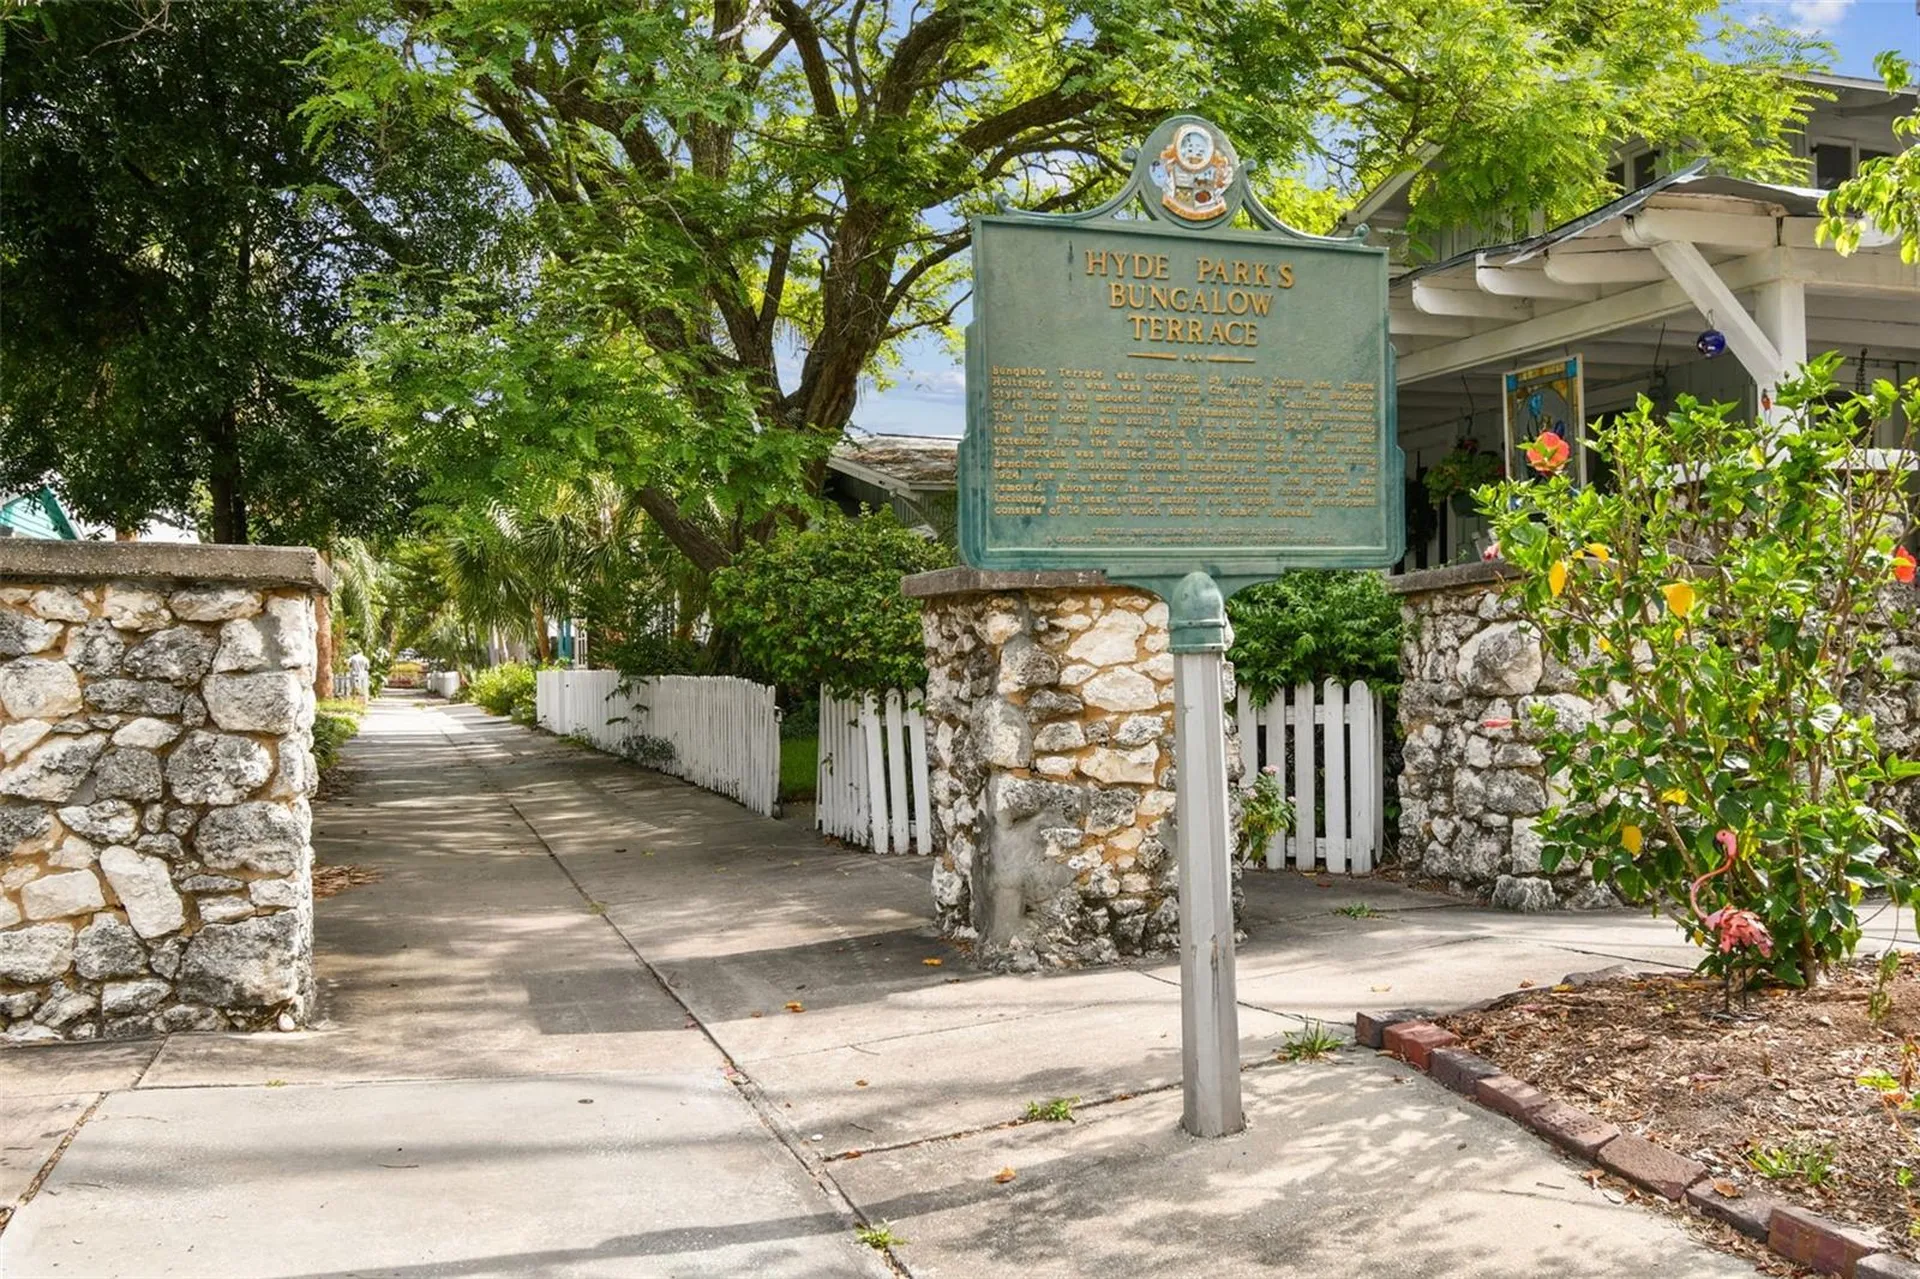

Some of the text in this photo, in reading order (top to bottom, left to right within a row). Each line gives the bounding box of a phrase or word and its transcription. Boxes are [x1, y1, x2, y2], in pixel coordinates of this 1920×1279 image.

[1085, 249, 1294, 288] HYDE PARK'S
[1109, 282, 1273, 317] BUNGALOW
[1128, 313, 1258, 346] TERRACE
